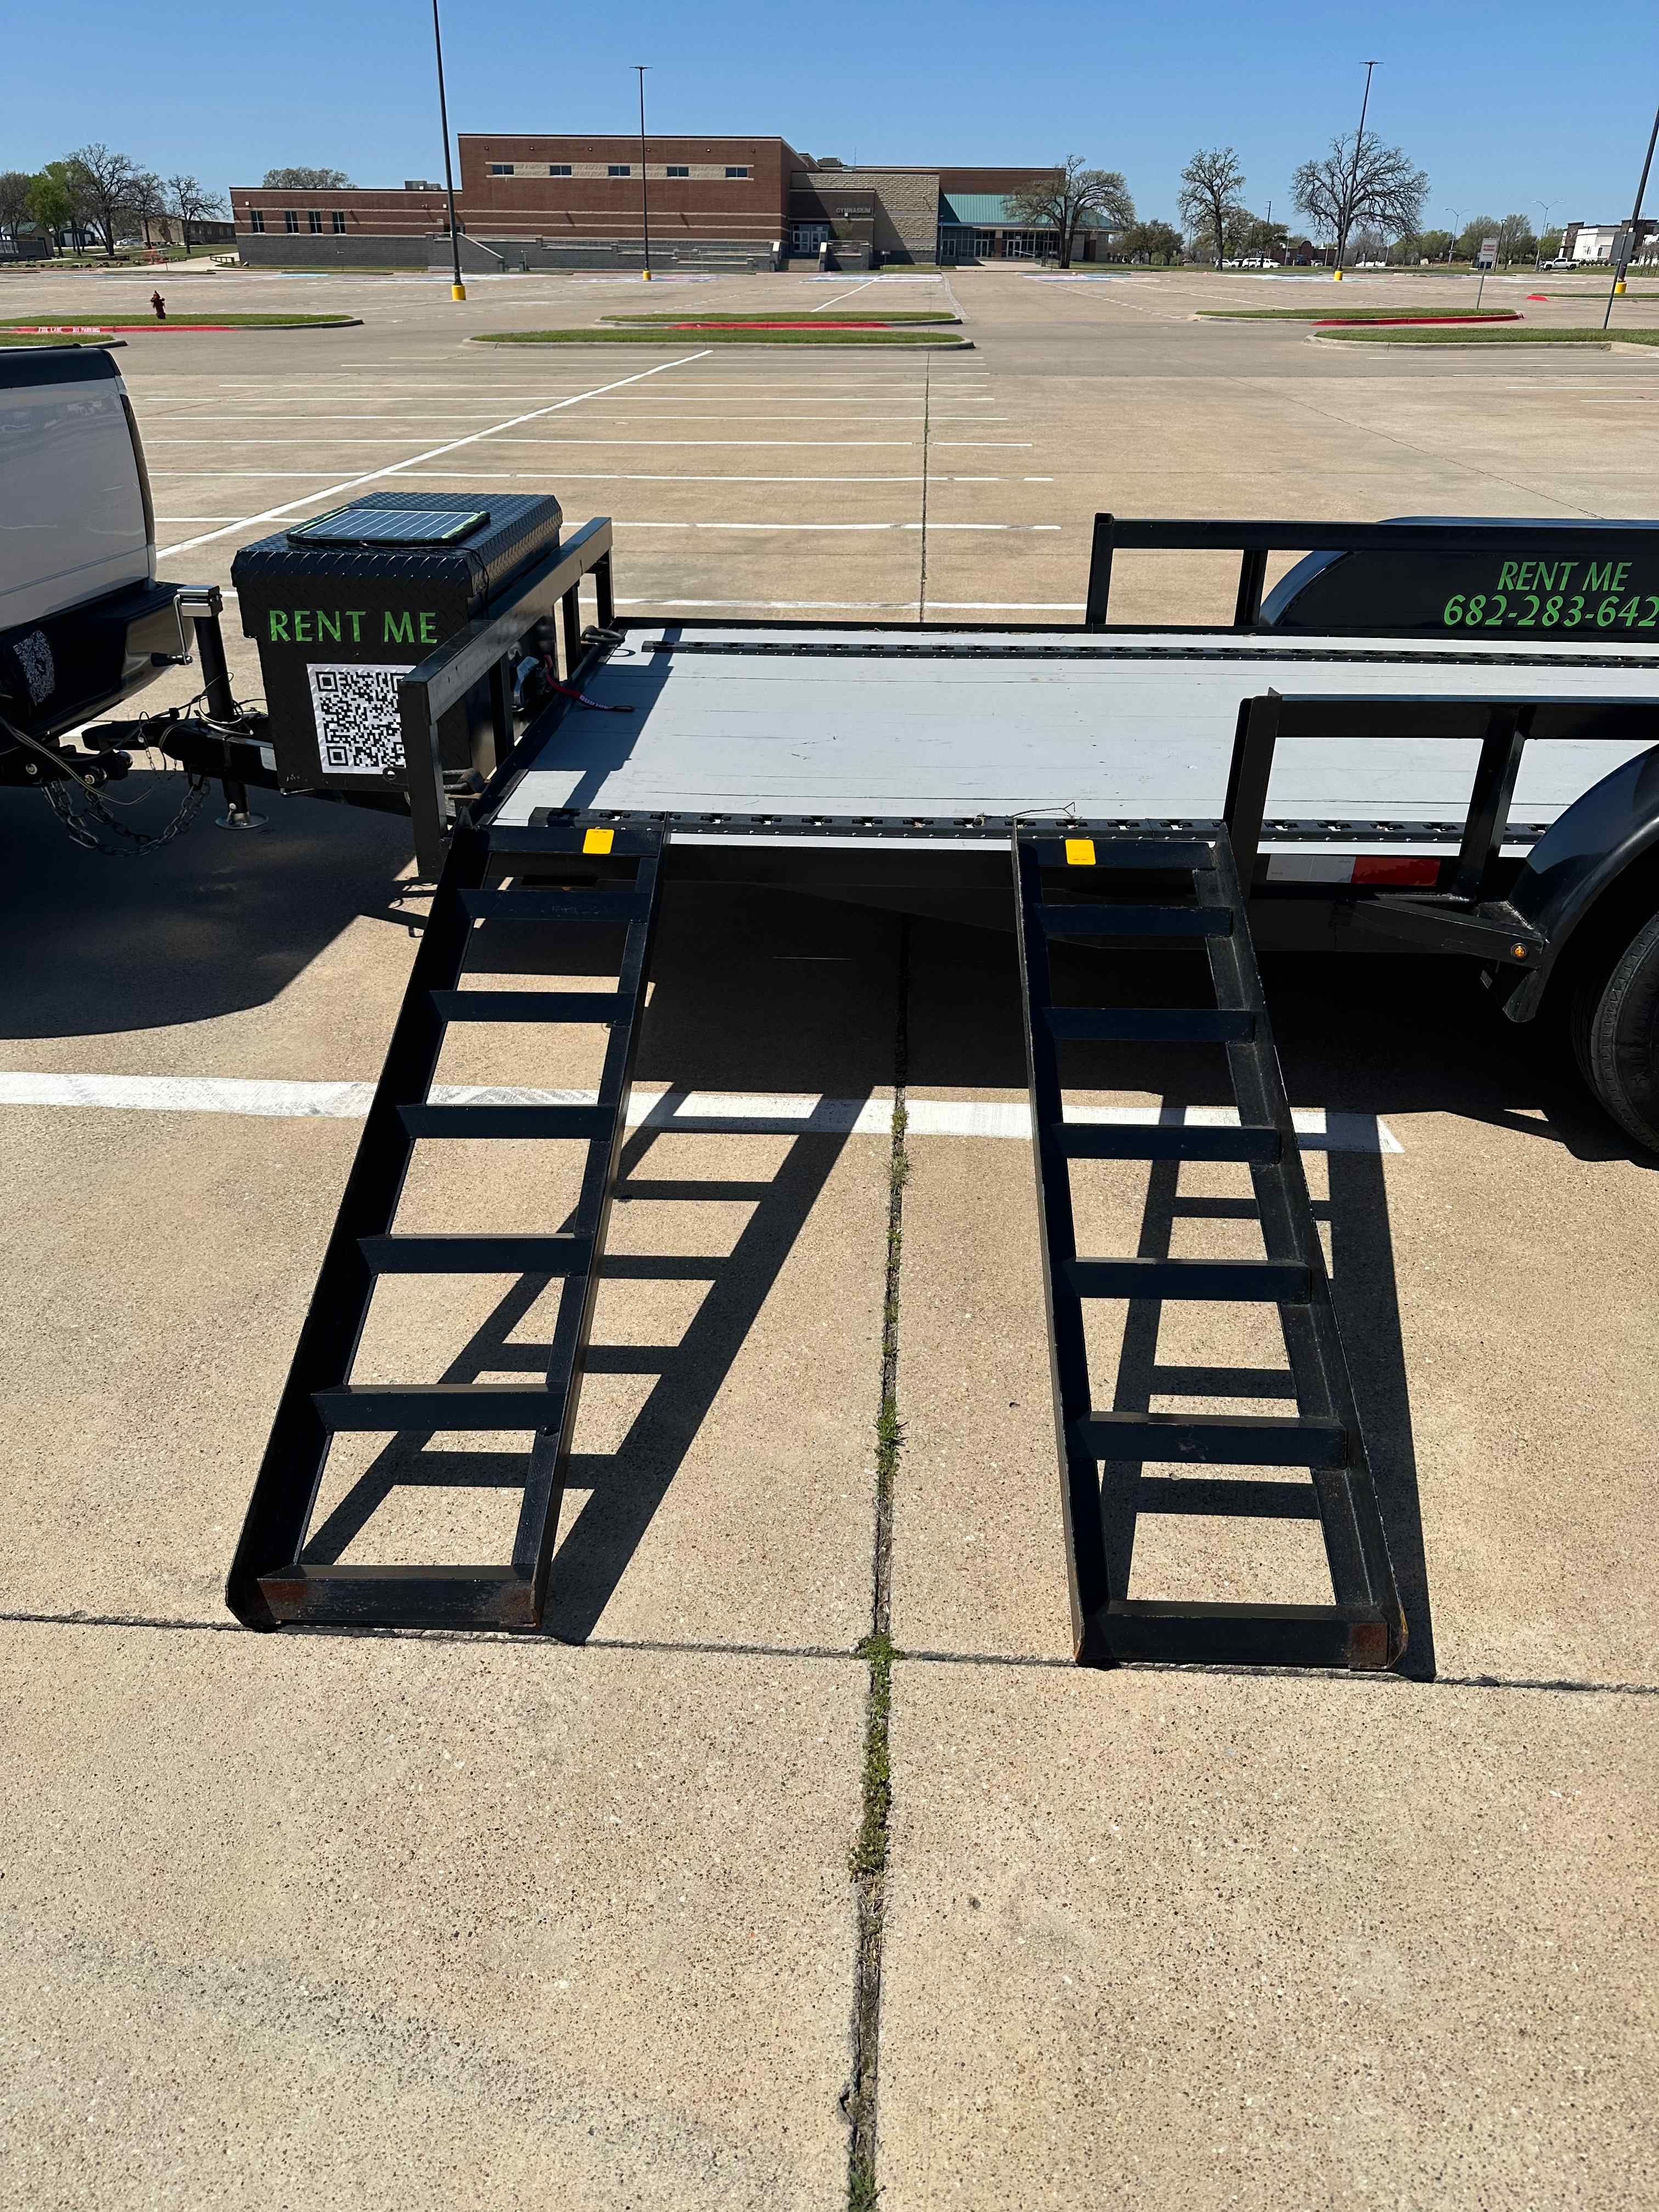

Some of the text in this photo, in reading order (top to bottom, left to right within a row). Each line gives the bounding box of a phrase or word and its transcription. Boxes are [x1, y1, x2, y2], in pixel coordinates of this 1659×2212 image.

[1497, 561, 1633, 592] RENT ME
[269, 610, 438, 644] RENT ME
[1443, 594, 1659, 627] 682-283-642
